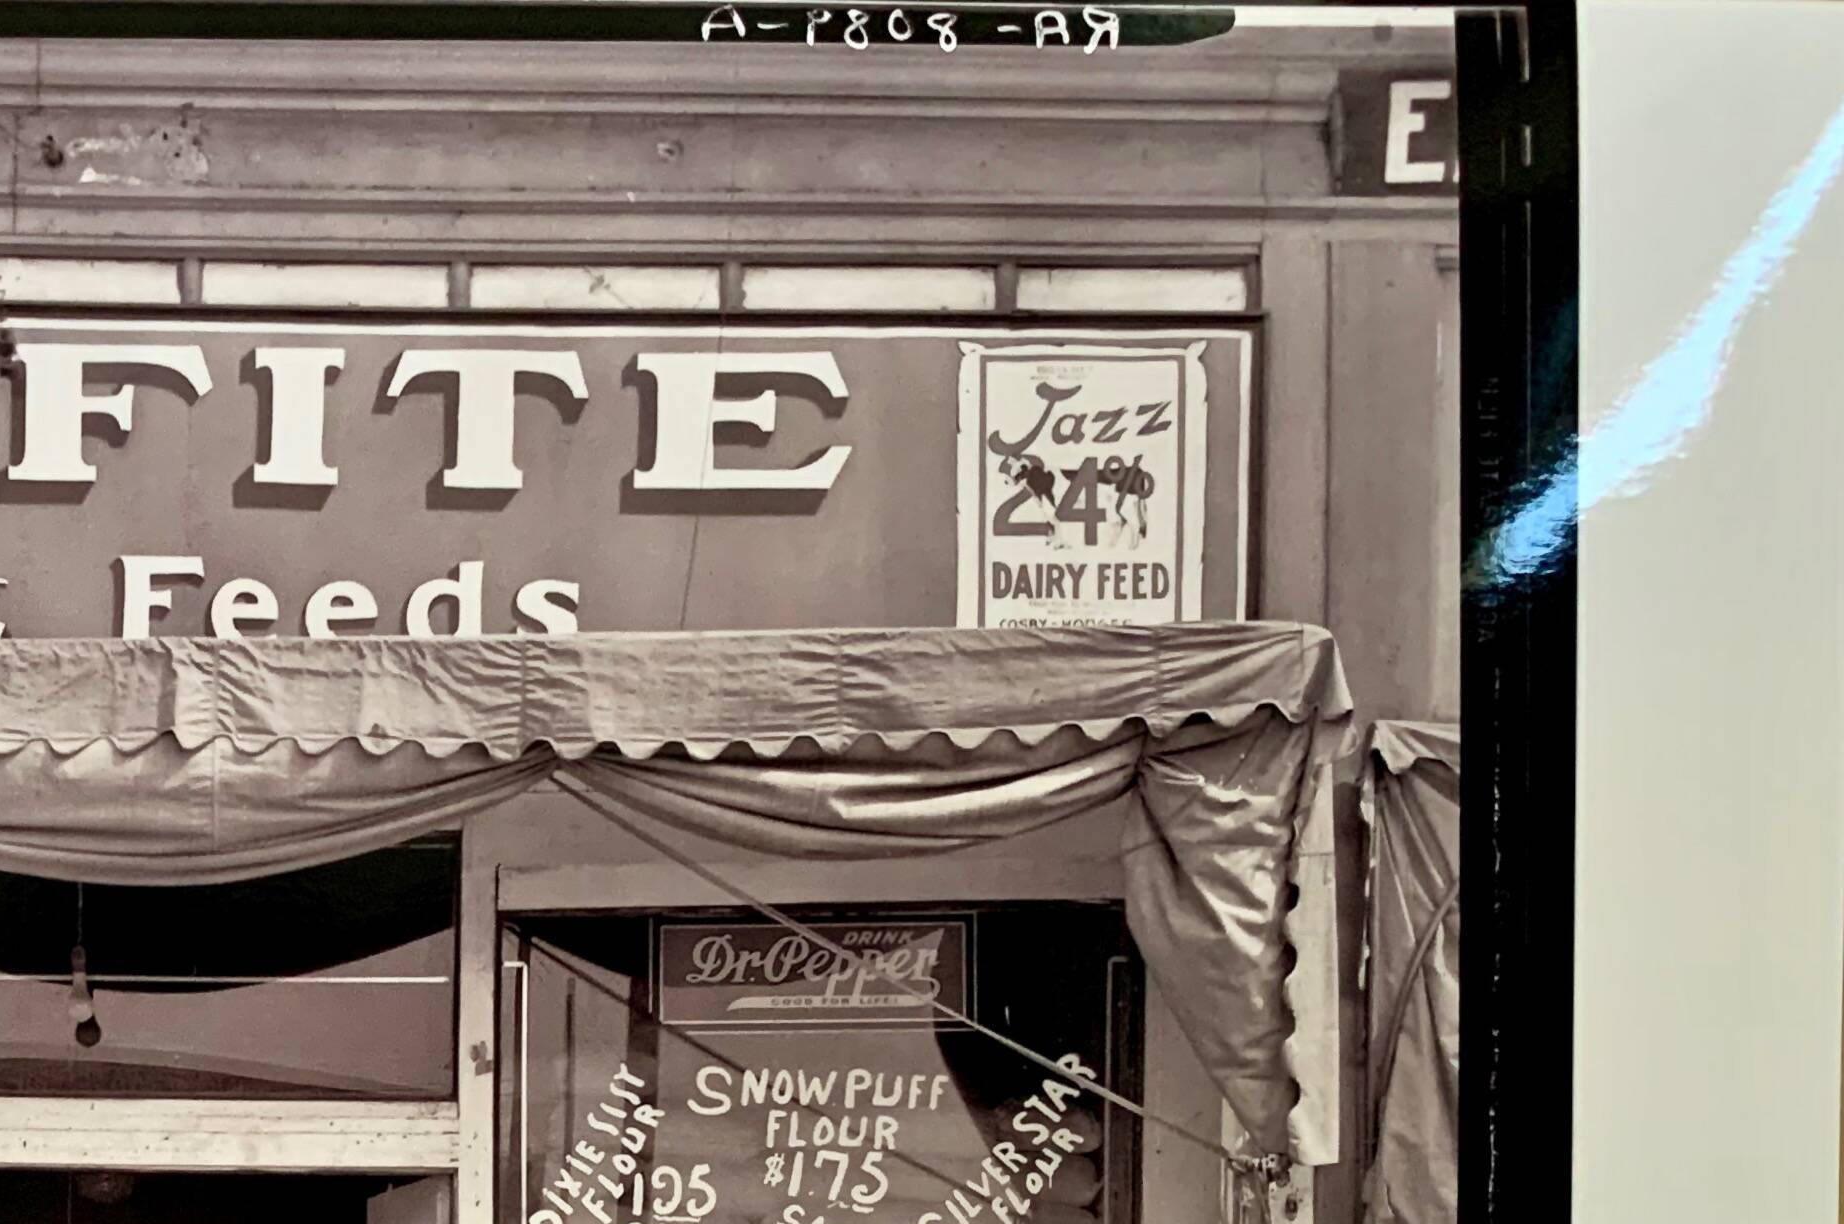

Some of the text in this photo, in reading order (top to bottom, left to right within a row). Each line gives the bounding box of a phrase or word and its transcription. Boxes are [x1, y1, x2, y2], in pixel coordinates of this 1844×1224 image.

[8, 344, 852, 490] FITE
[988, 382, 1172, 456] Jazz
[119, 555, 581, 638] Feeds
[992, 561, 1169, 599] DAIRY FEED
[843, 931, 914, 945] DRINK
[771, 998, 813, 1006] GOOD
[822, 998, 850, 1006] FOR
[845, 1069, 950, 1110] PUFF
[1013, 1053, 1097, 1146] STAR
[767, 1110, 899, 1150] FLOUR
[582, 1104, 665, 1224] FLOUR
